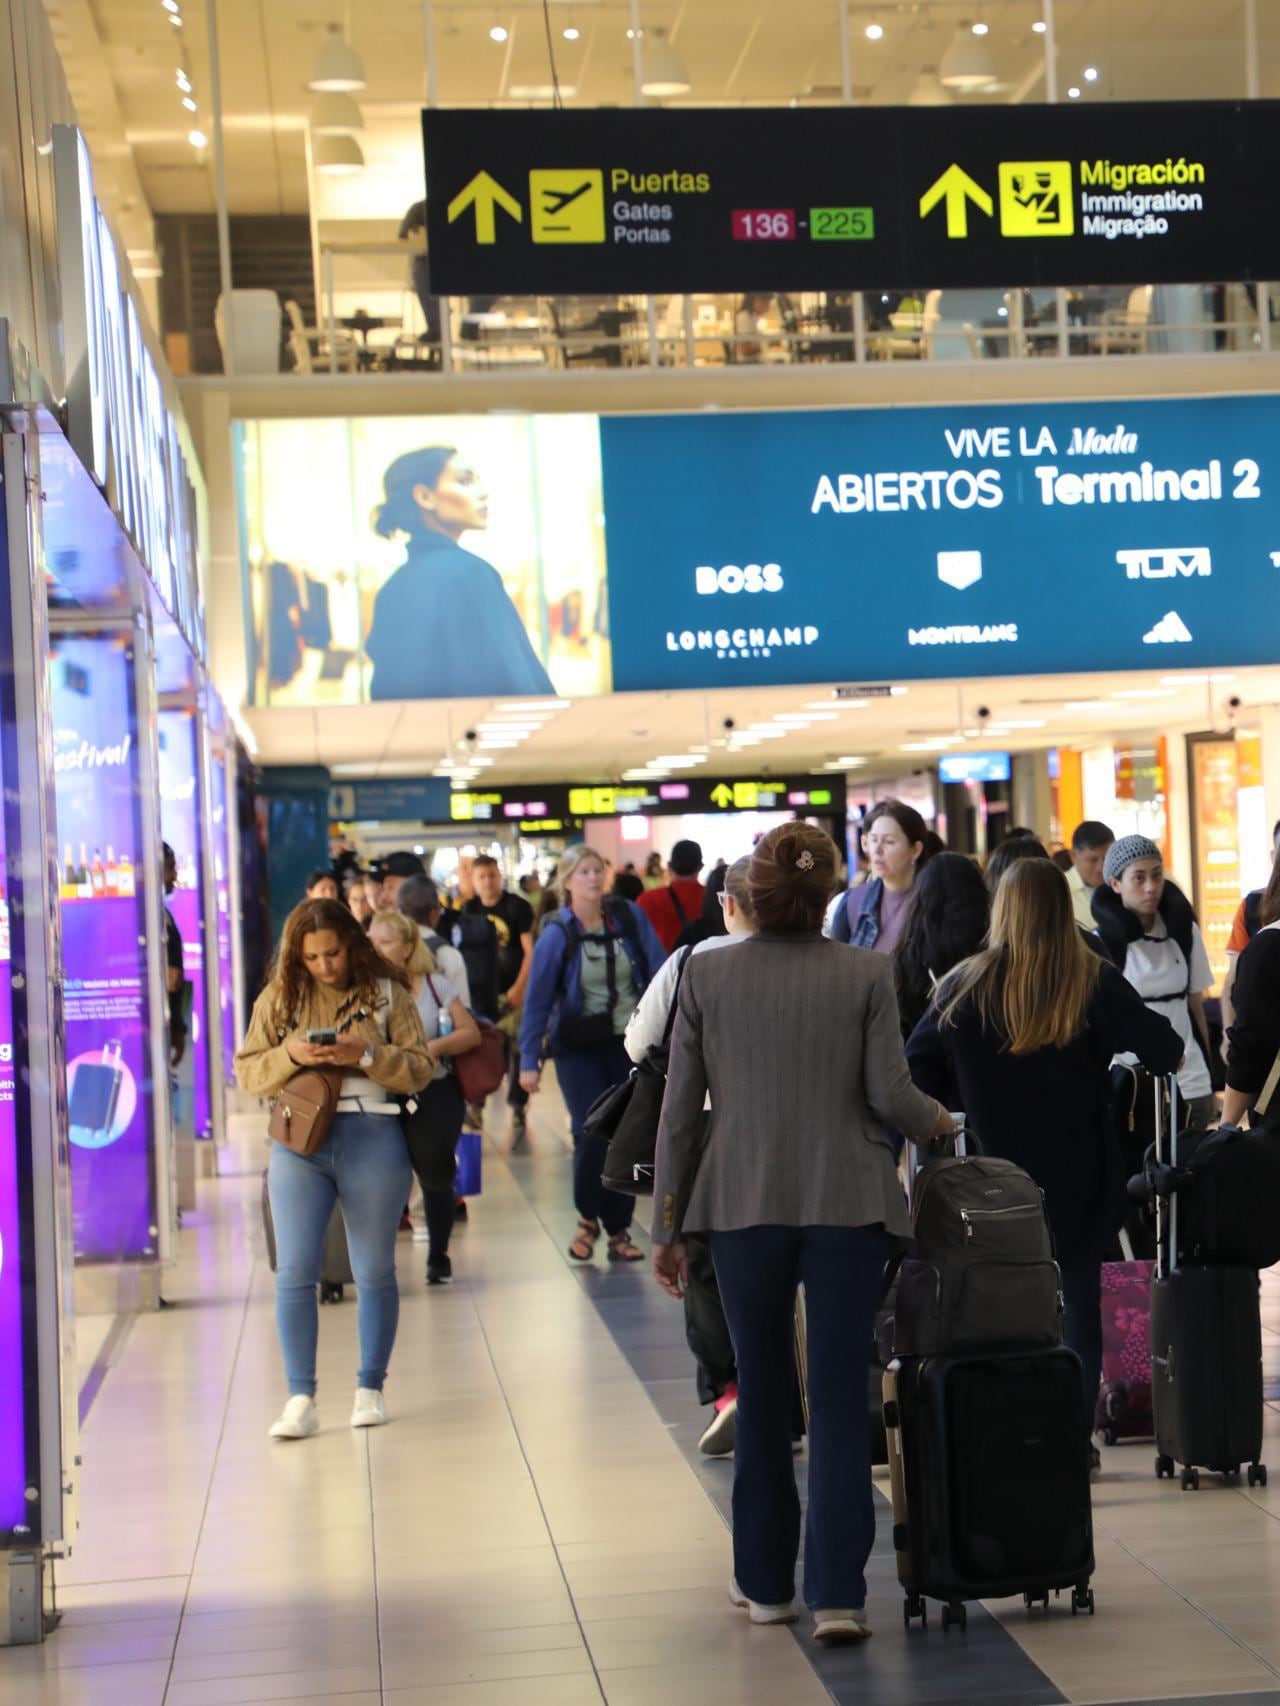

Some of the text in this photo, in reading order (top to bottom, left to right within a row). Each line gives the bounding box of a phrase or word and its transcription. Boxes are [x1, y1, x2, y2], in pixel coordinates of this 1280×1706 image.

[611, 169, 711, 193] Puertas
[1080, 157, 1205, 191] Migración
[613, 201, 672, 221] Gates
[1081, 190, 1203, 217] Immigration
[614, 226, 671, 243] Portas
[741, 213, 789, 238] 136
[817, 212, 867, 235] 225
[1083, 214, 1168, 239] Migração
[945, 424, 1138, 458] VIVE LA Moda
[811, 459, 1261, 513] ABIERTOS Terminal 2
[695, 563, 784, 594] BOSS
[666, 625, 819, 651] LONGCHAMP
